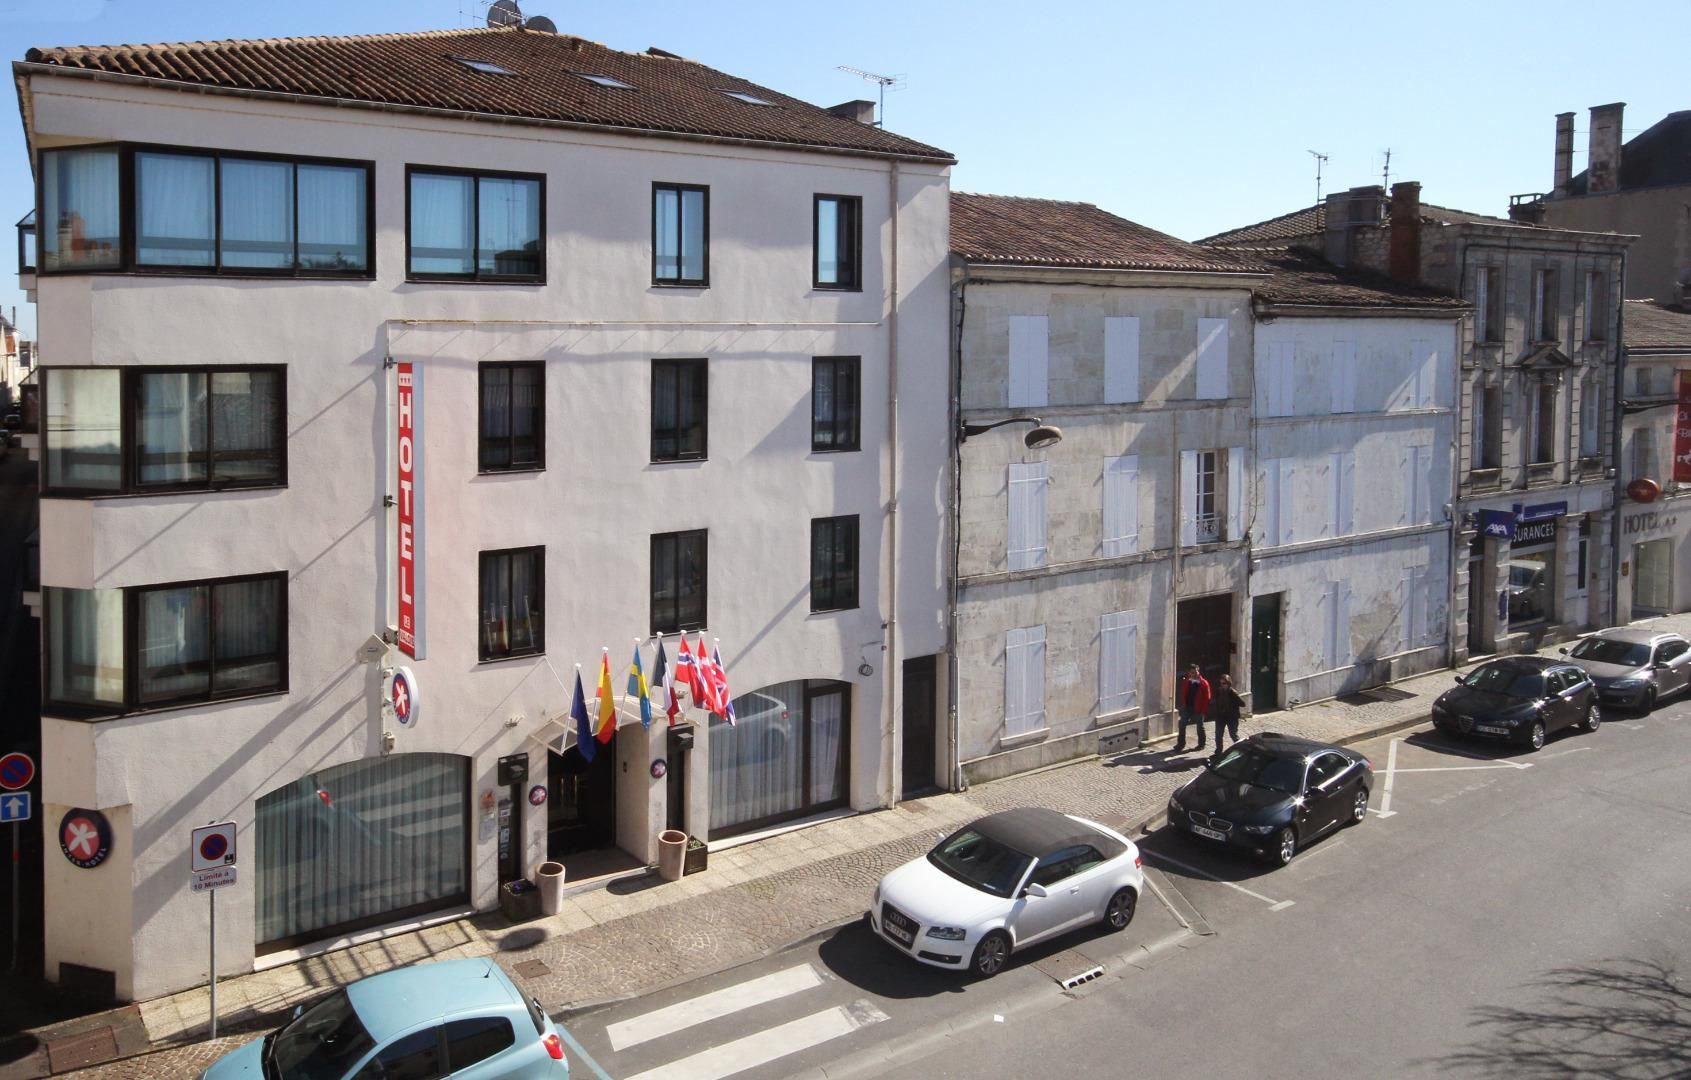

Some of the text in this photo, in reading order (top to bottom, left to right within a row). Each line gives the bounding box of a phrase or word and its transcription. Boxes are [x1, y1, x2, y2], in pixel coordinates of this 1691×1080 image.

[399, 394, 413, 604] HOTEL
[1485, 523, 1508, 536] AXA
[204, 879, 234, 889] Minutes
